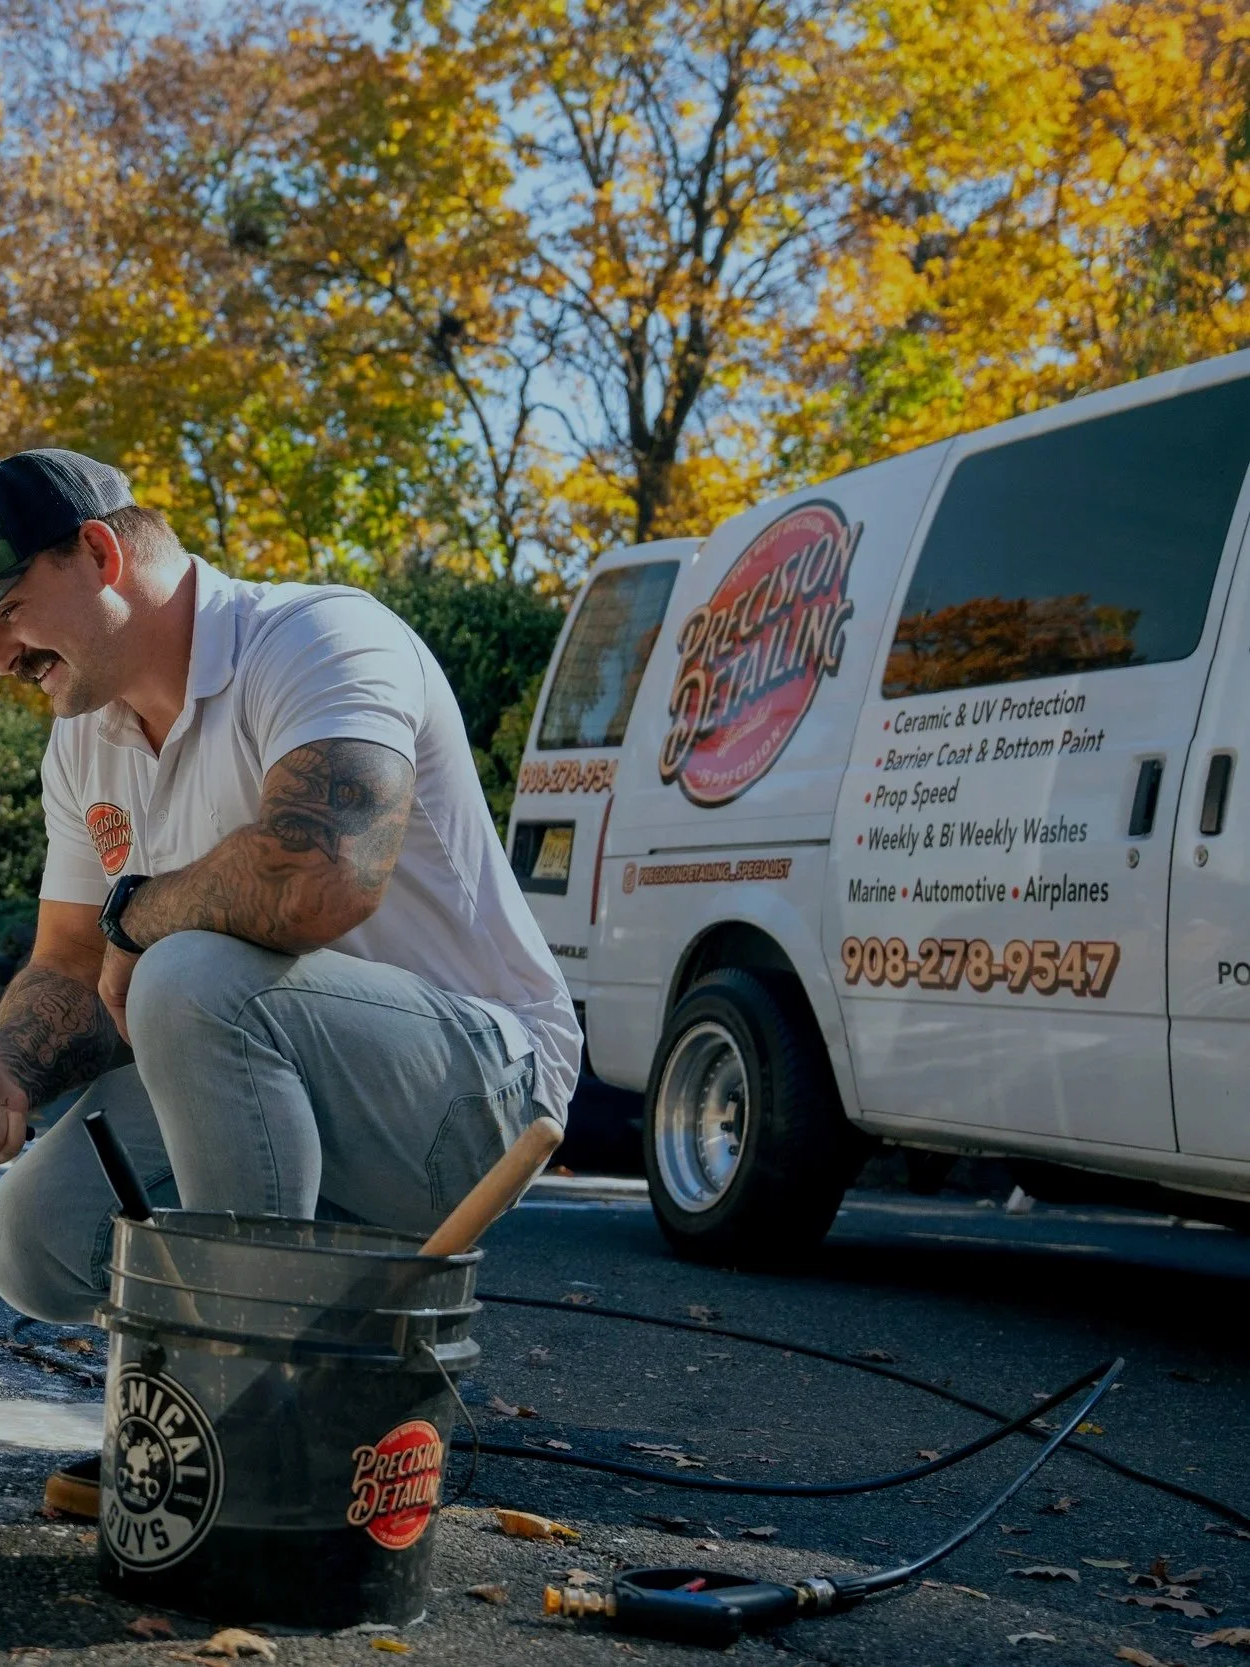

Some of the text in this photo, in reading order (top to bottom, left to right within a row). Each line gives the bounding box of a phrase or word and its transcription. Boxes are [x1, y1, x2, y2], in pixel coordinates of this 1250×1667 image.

[670, 521, 864, 716] PRECISION
[659, 600, 854, 785] DETAILING
[894, 689, 1086, 734] Ceramic & UV Protection
[883, 727, 1106, 772] Barrier Coat & Bottom Paint
[519, 758, 618, 794] 908-278-954
[873, 776, 961, 813] Prop Speed
[868, 814, 1088, 857] Weekly & Bi Weekly Washes
[848, 873, 1109, 910] Marine Automotive Airplanes
[841, 936, 1121, 998] 908-278-9547
[1218, 961, 1250, 986] PO
[116, 1379, 208, 1484] EMICAL
[350, 1441, 444, 1494] PRECISION
[106, 1502, 172, 1555] GUYS
